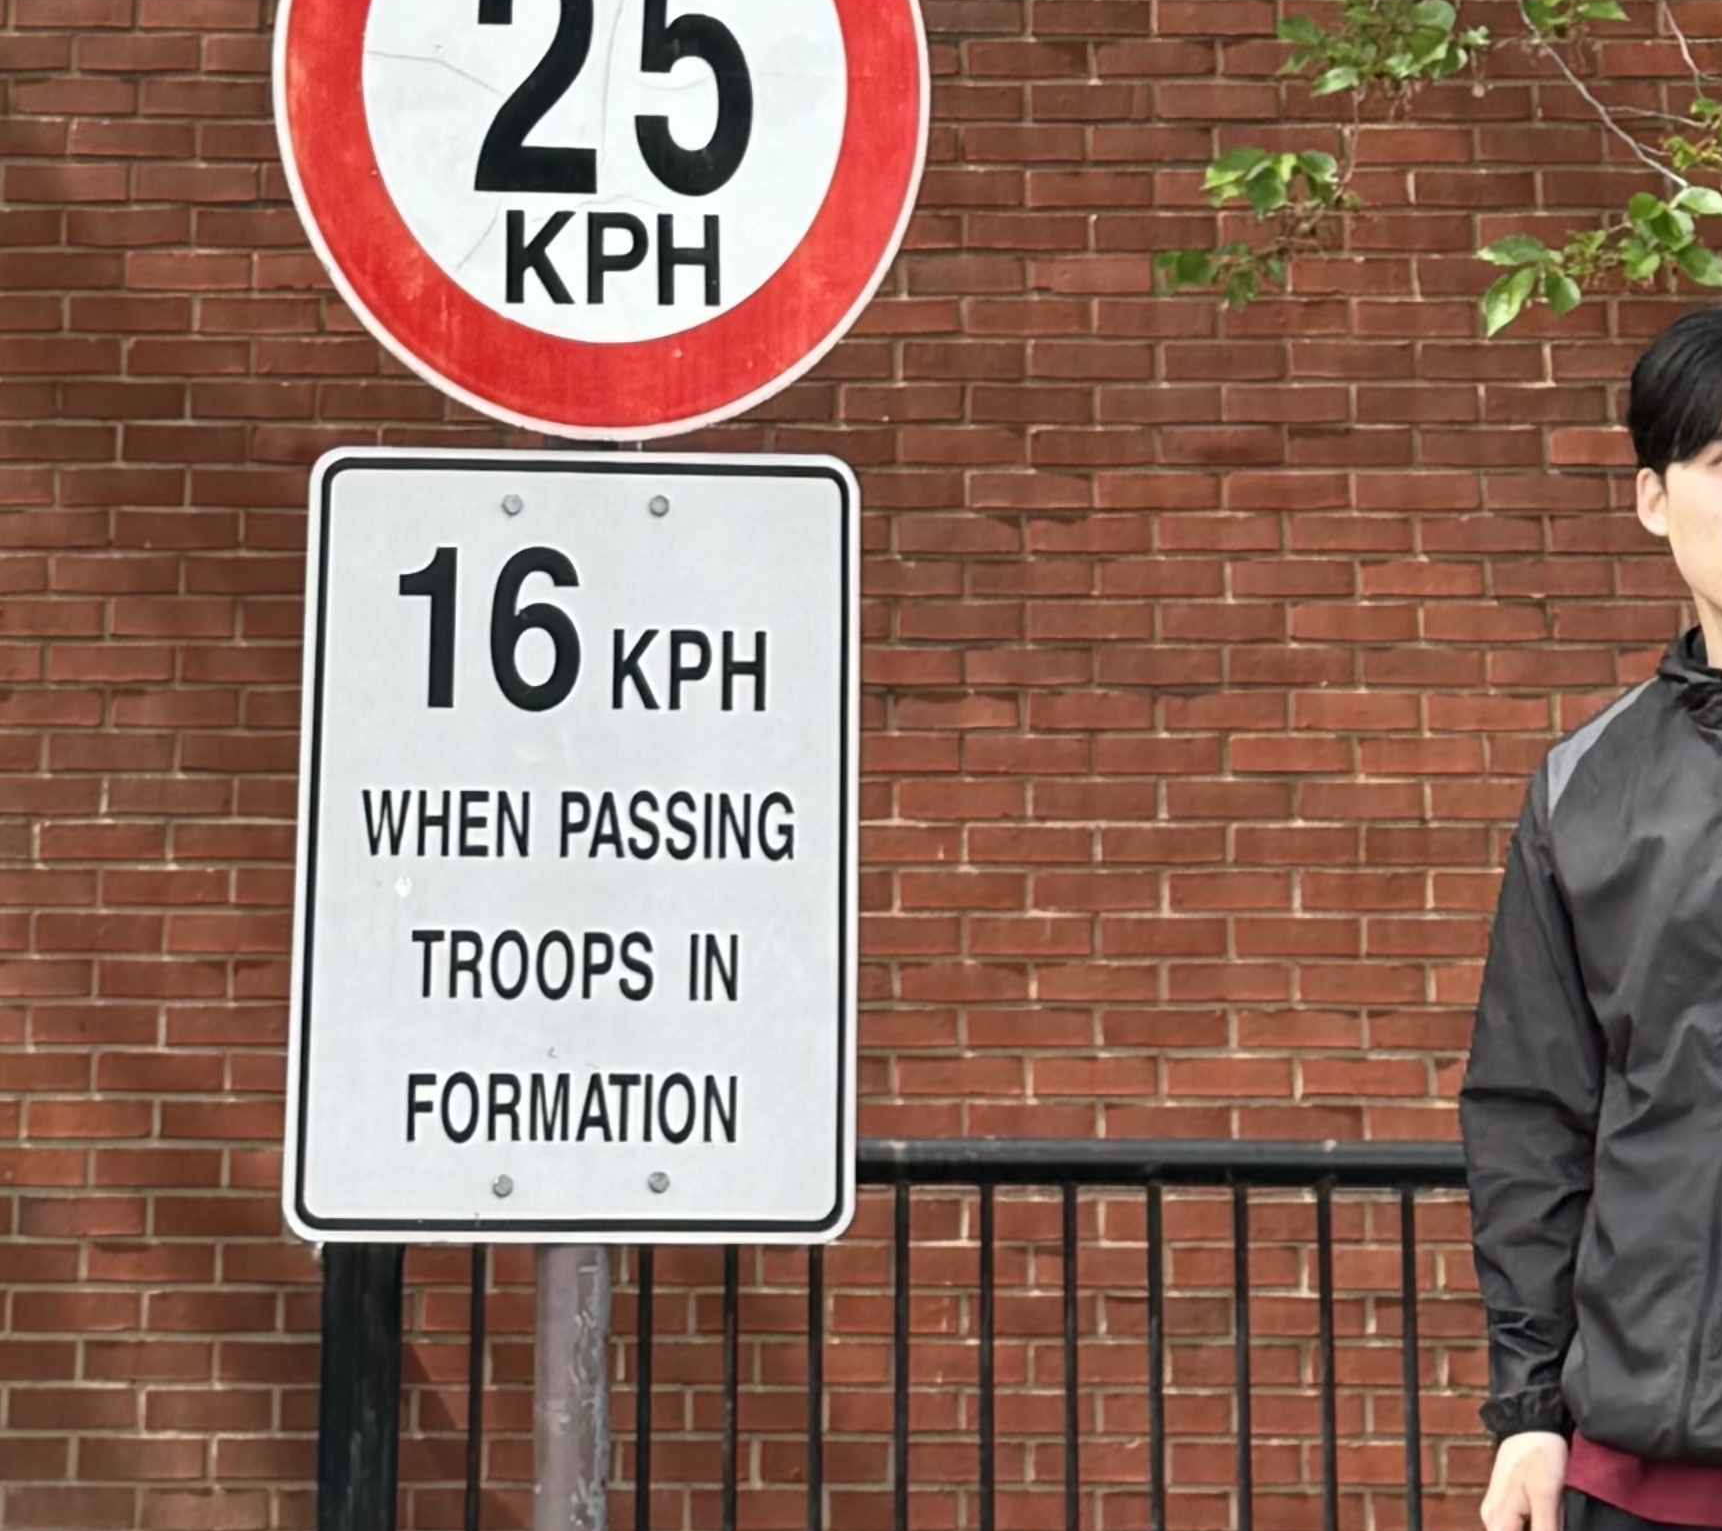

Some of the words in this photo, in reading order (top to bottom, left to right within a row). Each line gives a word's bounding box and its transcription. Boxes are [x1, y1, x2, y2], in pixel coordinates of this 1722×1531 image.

[504, 208, 721, 307] KPH
[398, 545, 581, 713] 16
[611, 627, 767, 712] KPH
[361, 788, 531, 858] WHEN
[558, 789, 796, 862] PASSING
[411, 928, 655, 1002] TROOPS
[687, 932, 739, 1002] IN
[405, 1070, 738, 1145] FORMATION
